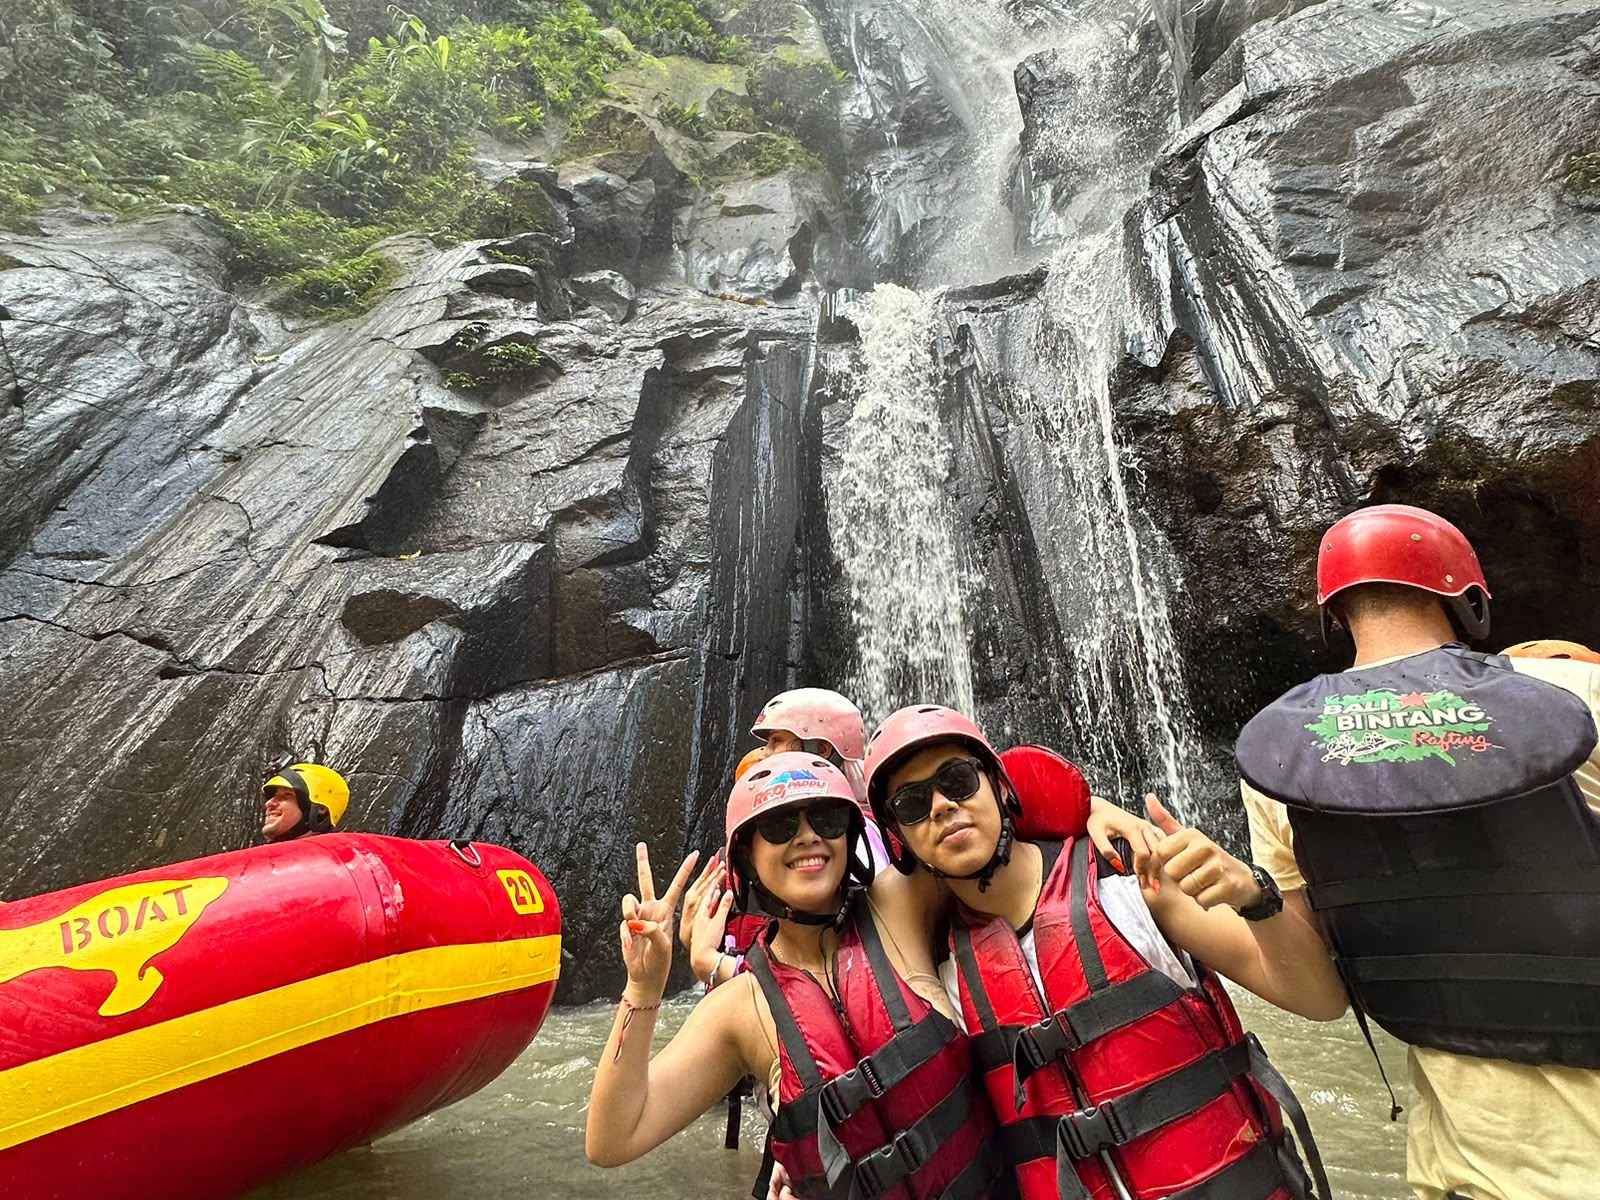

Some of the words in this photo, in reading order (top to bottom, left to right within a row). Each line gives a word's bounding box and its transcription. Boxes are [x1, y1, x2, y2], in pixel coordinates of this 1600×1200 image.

[1323, 698, 1390, 715] BALI
[1336, 706, 1485, 732] BINTANG
[1413, 731, 1490, 752] Rafting
[60, 884, 192, 954] BOAT
